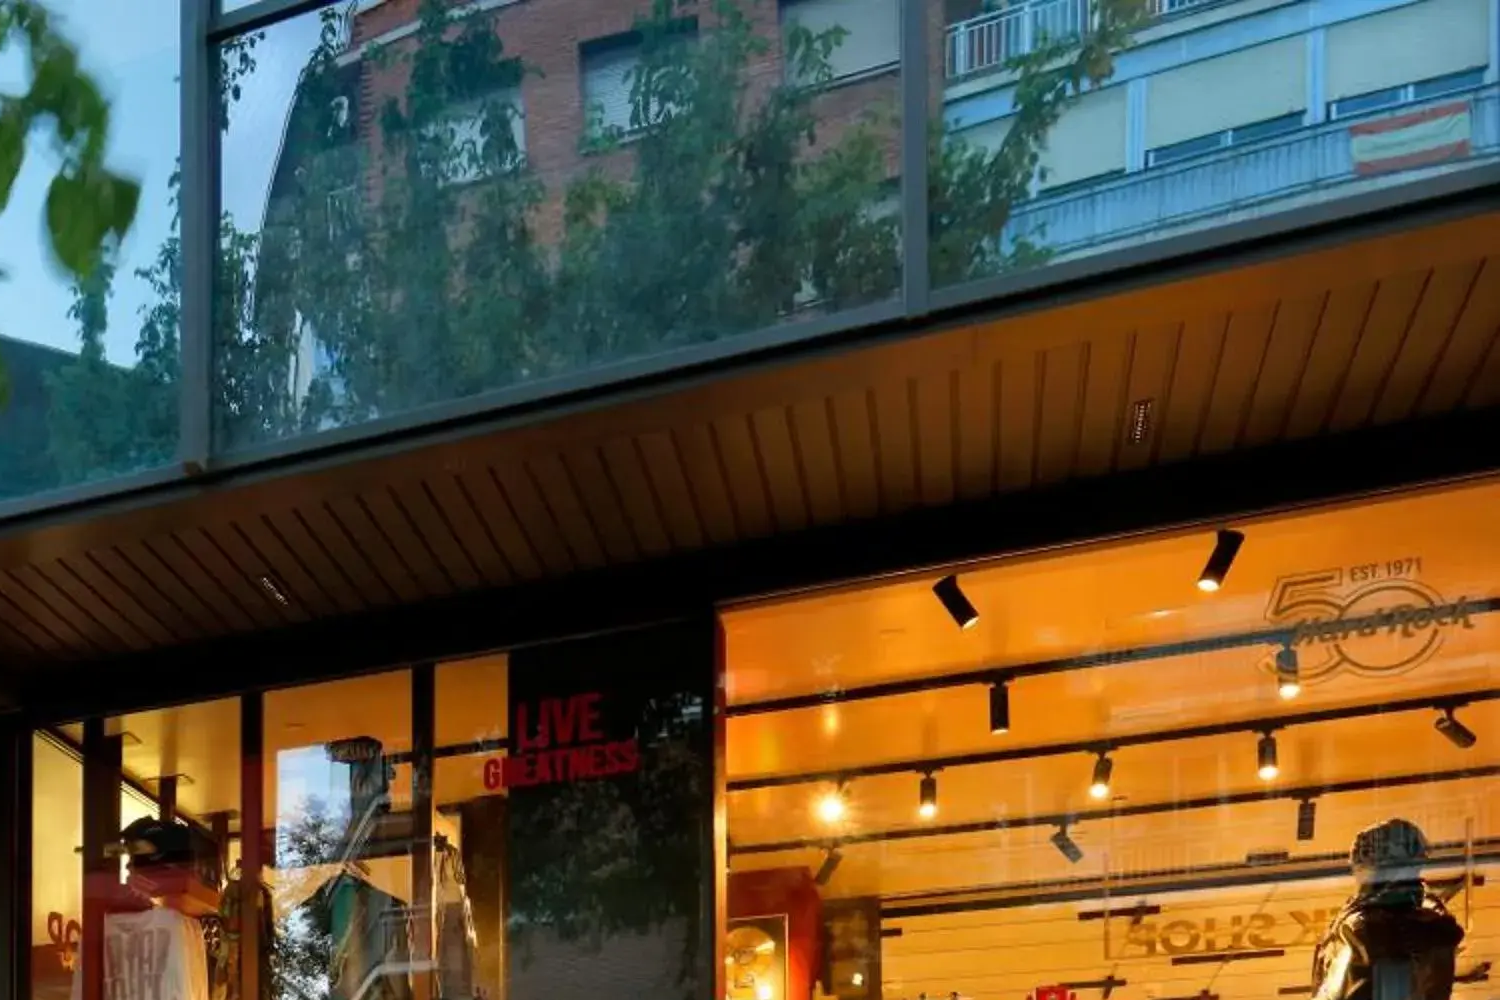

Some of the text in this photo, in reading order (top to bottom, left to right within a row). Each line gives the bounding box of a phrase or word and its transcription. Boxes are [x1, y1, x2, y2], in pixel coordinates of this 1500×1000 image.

[1385, 556, 1423, 578] 1971
[515, 692, 606, 750] LIVE
[483, 738, 642, 790] GREATNESS
